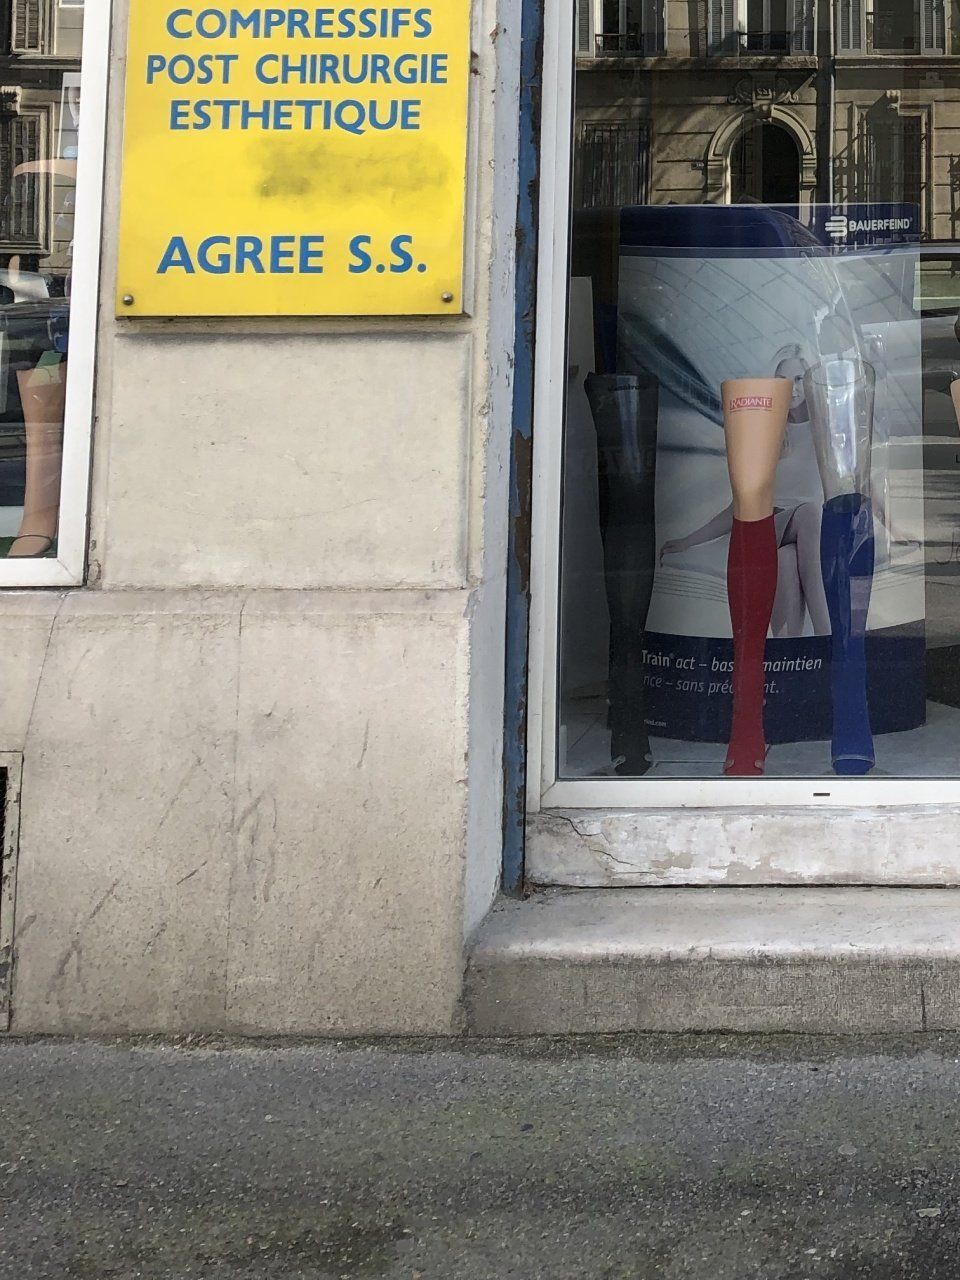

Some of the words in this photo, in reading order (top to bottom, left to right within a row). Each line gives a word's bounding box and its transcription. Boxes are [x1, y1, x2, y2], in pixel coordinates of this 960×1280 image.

[166, 8, 432, 39] COMPRESSIFS
[146, 54, 238, 84] POST
[255, 54, 448, 84] CHIRURGIE
[169, 99, 421, 135] ESTHETIQUE
[848, 218, 911, 232] BAUERFEIND
[156, 235, 324, 274] AGREE
[347, 234, 427, 274] S.S.
[729, 396, 772, 409] RADIANTE
[675, 656, 697, 670] act
[711, 656, 735, 672] bas
[675, 679, 705, 694] sans
